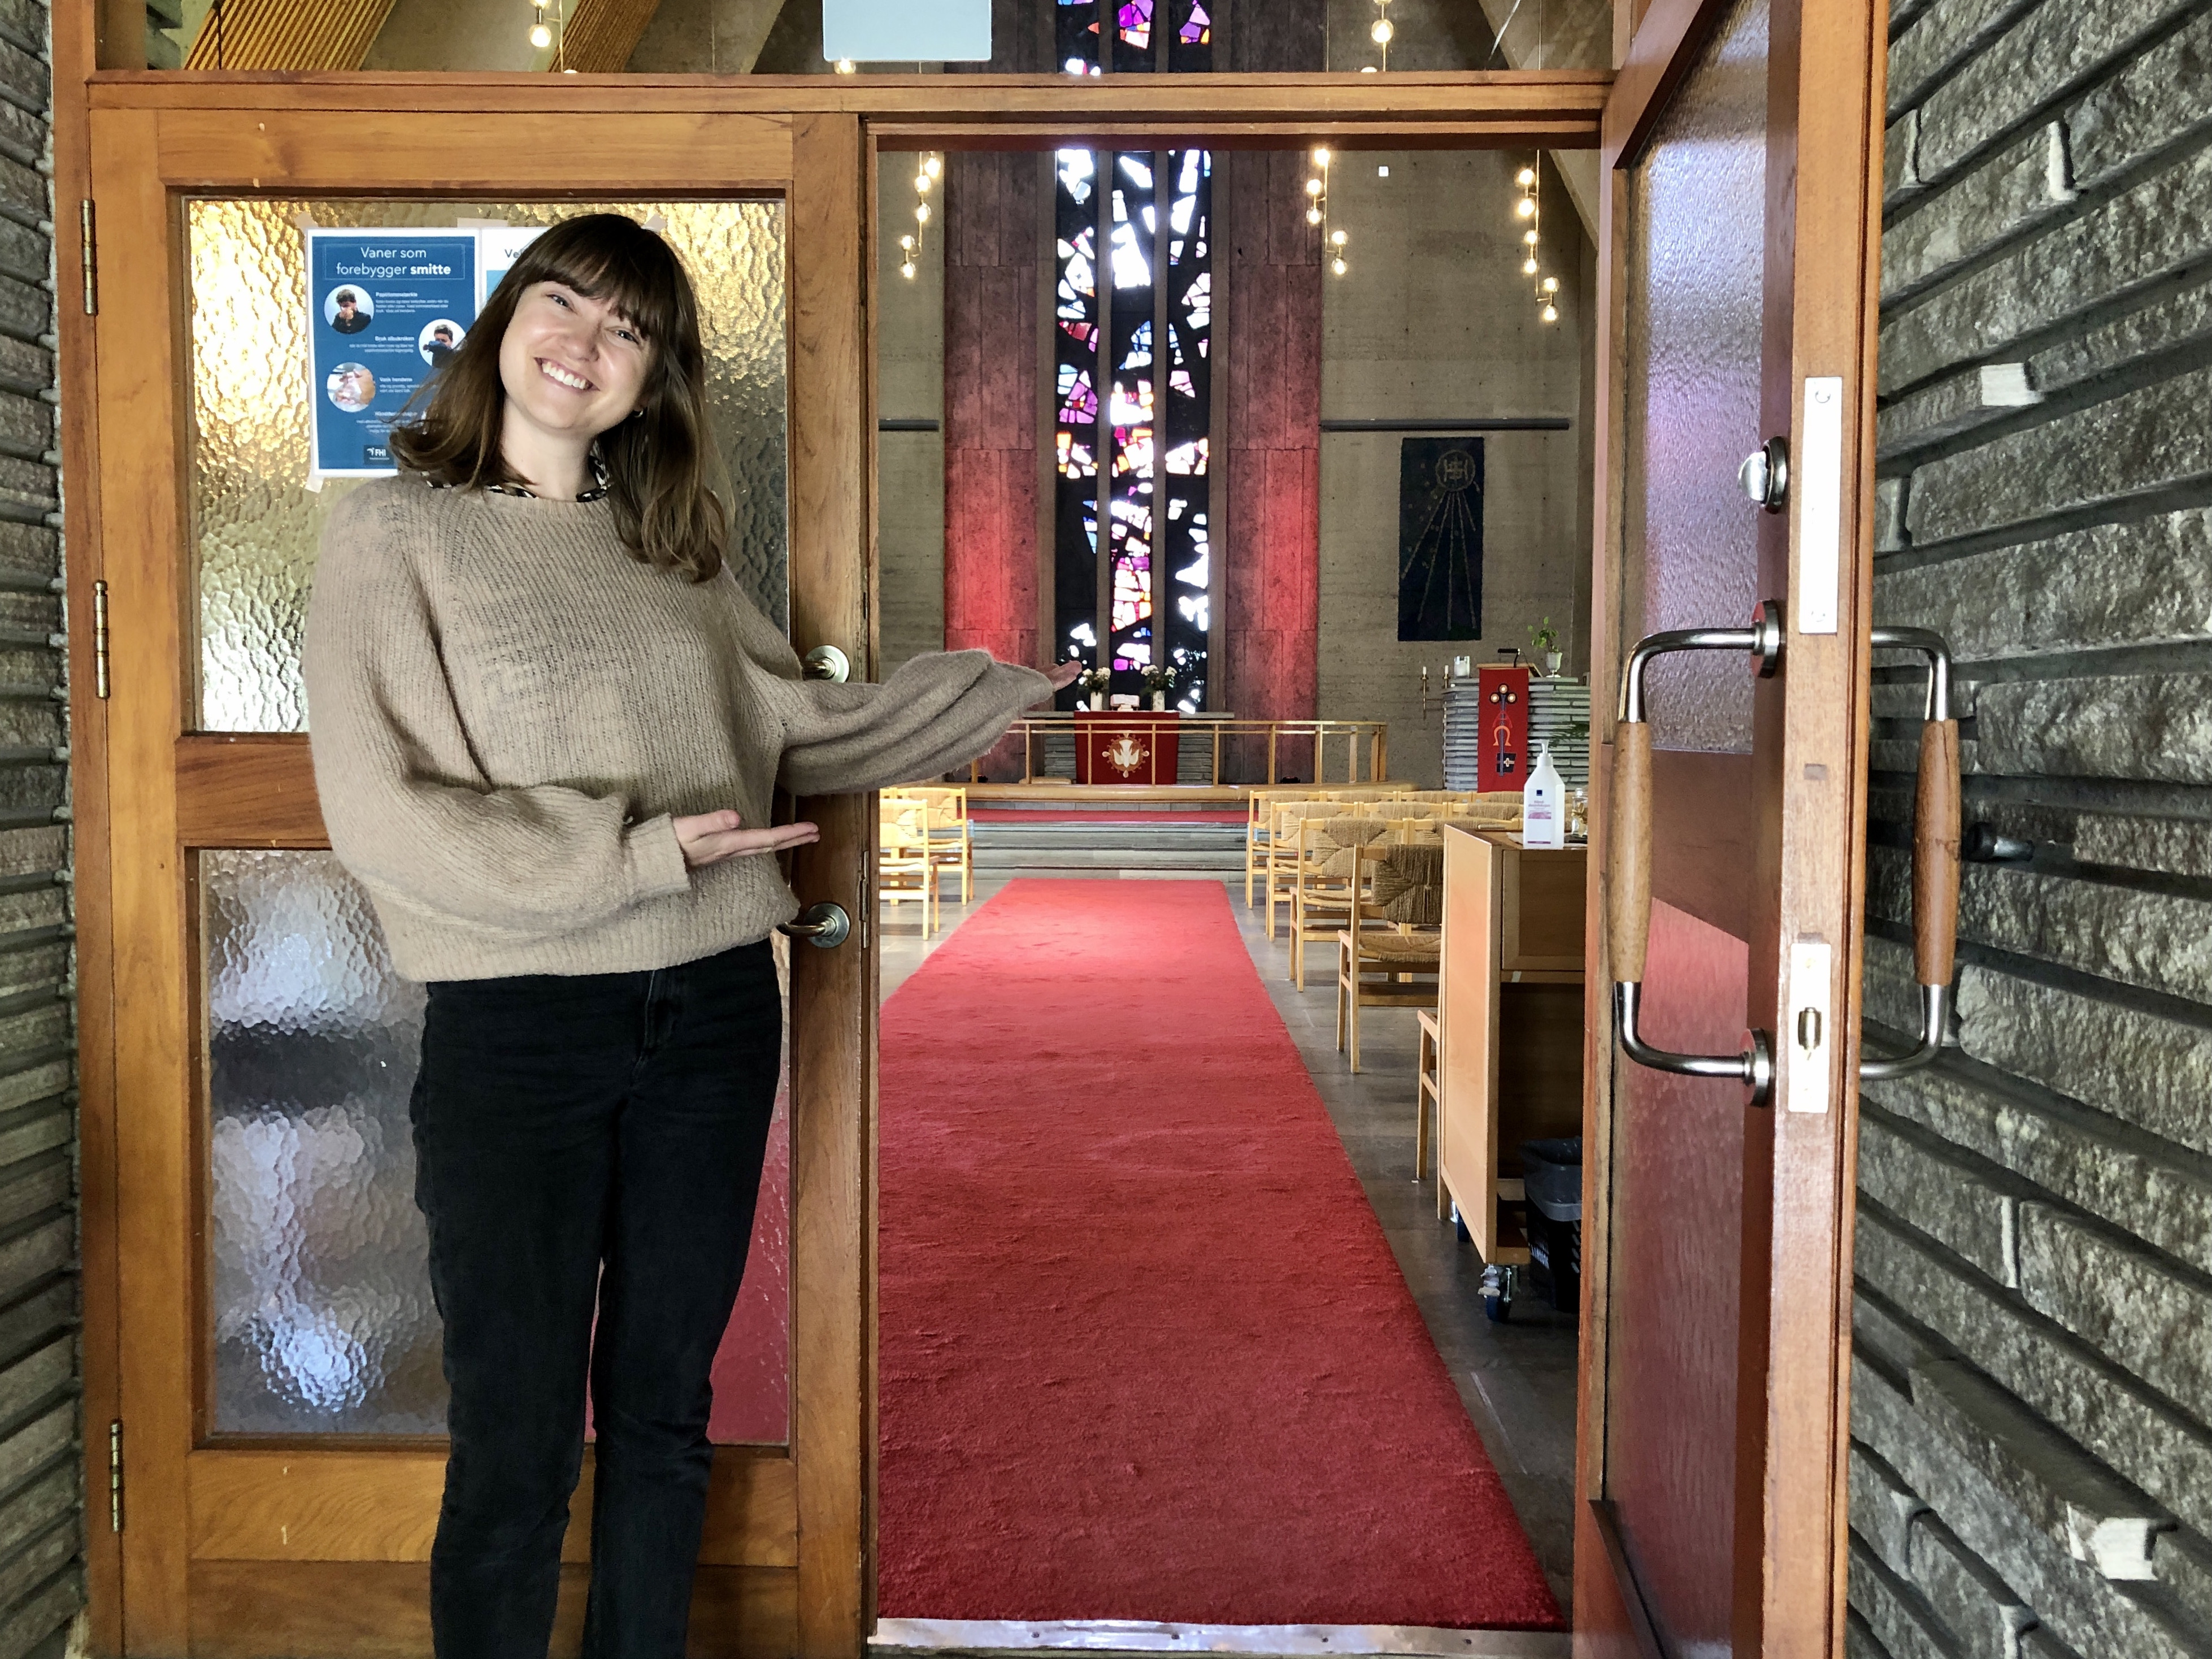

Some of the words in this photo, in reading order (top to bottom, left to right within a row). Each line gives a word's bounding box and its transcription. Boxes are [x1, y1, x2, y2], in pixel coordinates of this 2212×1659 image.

[360, 247, 397, 258] Vaner
[336, 262, 407, 277] forebygger
[410, 263, 451, 275] smitte
